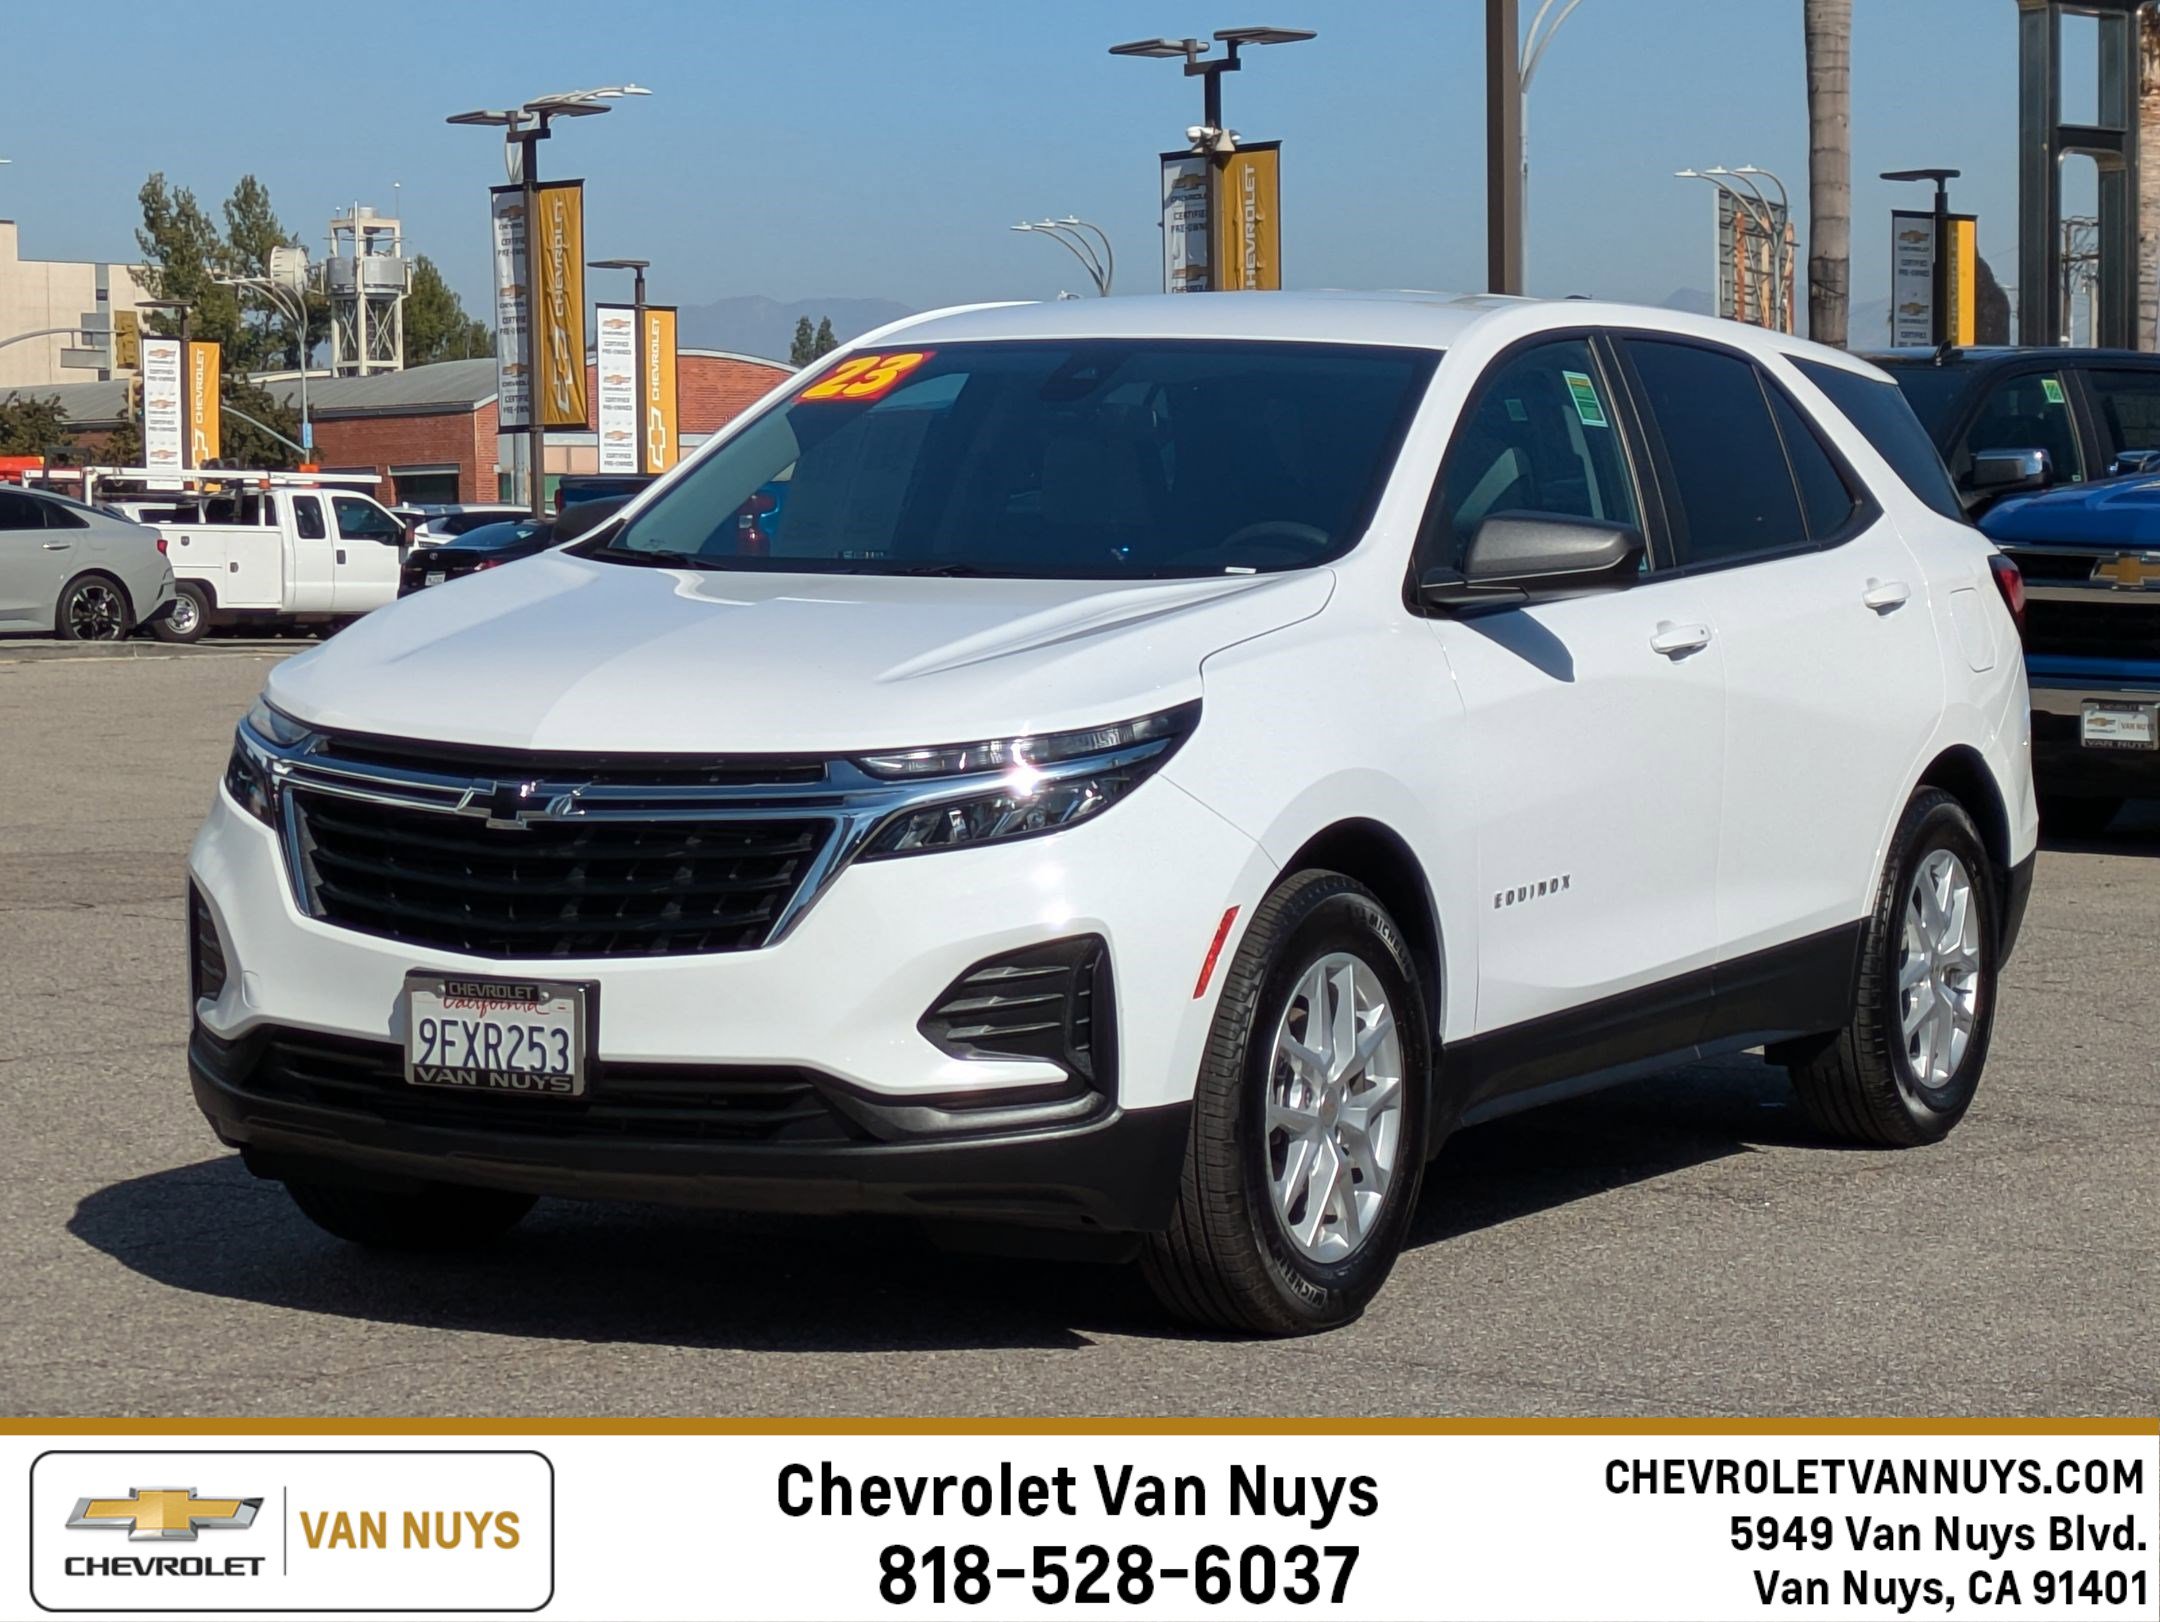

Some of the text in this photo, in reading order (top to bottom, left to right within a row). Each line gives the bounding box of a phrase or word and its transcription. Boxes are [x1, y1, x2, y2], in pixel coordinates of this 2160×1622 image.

[1245, 163, 1256, 290] HEVROLET
[554, 196, 565, 317] CHEVROLET
[195, 346, 205, 424] CHEVROLET
[651, 317, 661, 401] CHEVROLET
[801, 353, 924, 400] 23
[2086, 739, 2112, 748] VAN
[1494, 873, 1571, 910] EQUINOX
[449, 981, 535, 1000] CHEVROLET
[418, 1017, 570, 1075] 9FXR253
[415, 1066, 572, 1093] VAN NUYS
